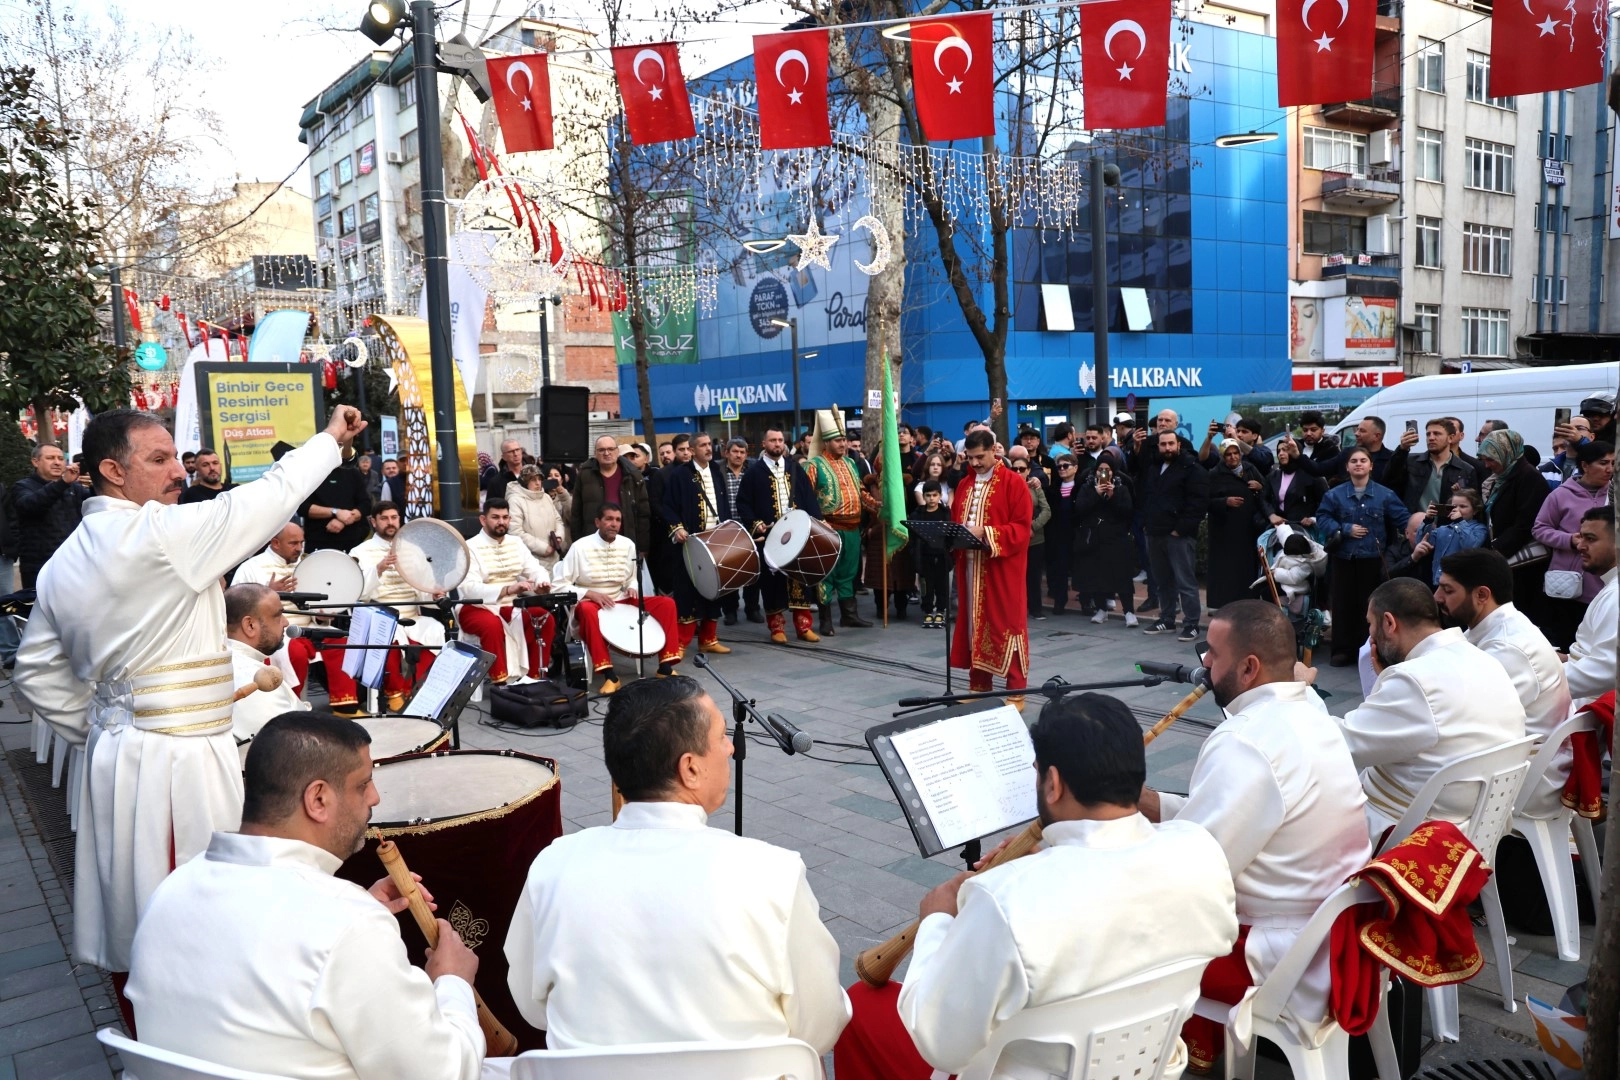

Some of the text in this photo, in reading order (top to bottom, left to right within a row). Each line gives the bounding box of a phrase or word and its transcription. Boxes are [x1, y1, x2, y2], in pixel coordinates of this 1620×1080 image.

[754, 291, 775, 303] PARAF
[756, 300, 775, 311] TCKN
[1319, 372, 1379, 388] ECZANE
[216, 381, 305, 393] Binbir Gece
[217, 395, 288, 408] Resimleri
[220, 410, 271, 424] Sergisi
[224, 428, 273, 438] Düş Atlası
